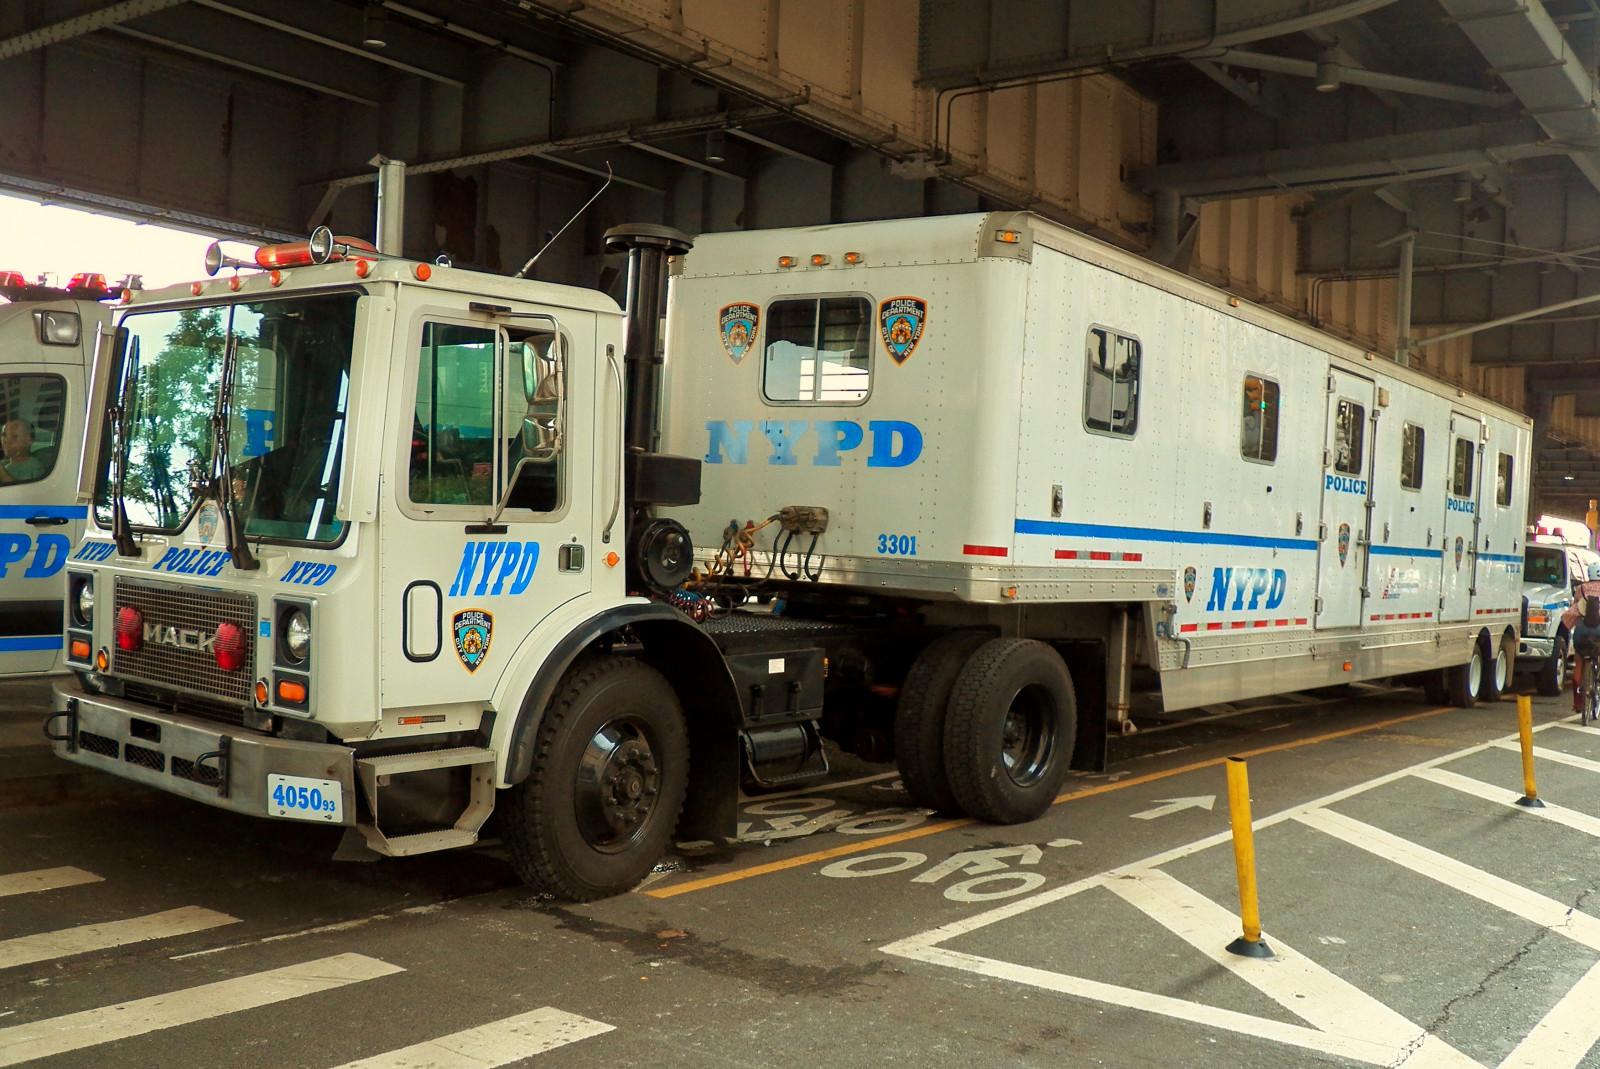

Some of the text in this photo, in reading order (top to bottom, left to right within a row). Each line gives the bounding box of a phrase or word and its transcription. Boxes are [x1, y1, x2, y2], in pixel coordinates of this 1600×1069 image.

[729, 305, 750, 313] POLICE
[882, 306, 924, 319] DEPARTMENT
[891, 299, 916, 307] POLICE
[722, 311, 757, 324] DEPARTMENT
[882, 327, 891, 343] CITY
[903, 321, 924, 356] NEW YORK
[705, 420, 923, 467] NYPD
[1325, 474, 1367, 495] POLICE
[1447, 497, 1475, 514] POLICE
[73, 541, 117, 562] NYPD
[877, 533, 917, 556] 3301
[153, 547, 232, 576] POLICE
[448, 542, 539, 596] NYPD
[279, 561, 338, 586] NYPD
[1205, 567, 1287, 611] NYPD
[454, 618, 491, 631] DEPARTMENT
[462, 611, 484, 619] POLICE
[142, 621, 216, 654] MACK
[455, 637, 464, 653] CITY
[475, 633, 491, 666] NEW YORK
[272, 784, 336, 812] 4050 93
